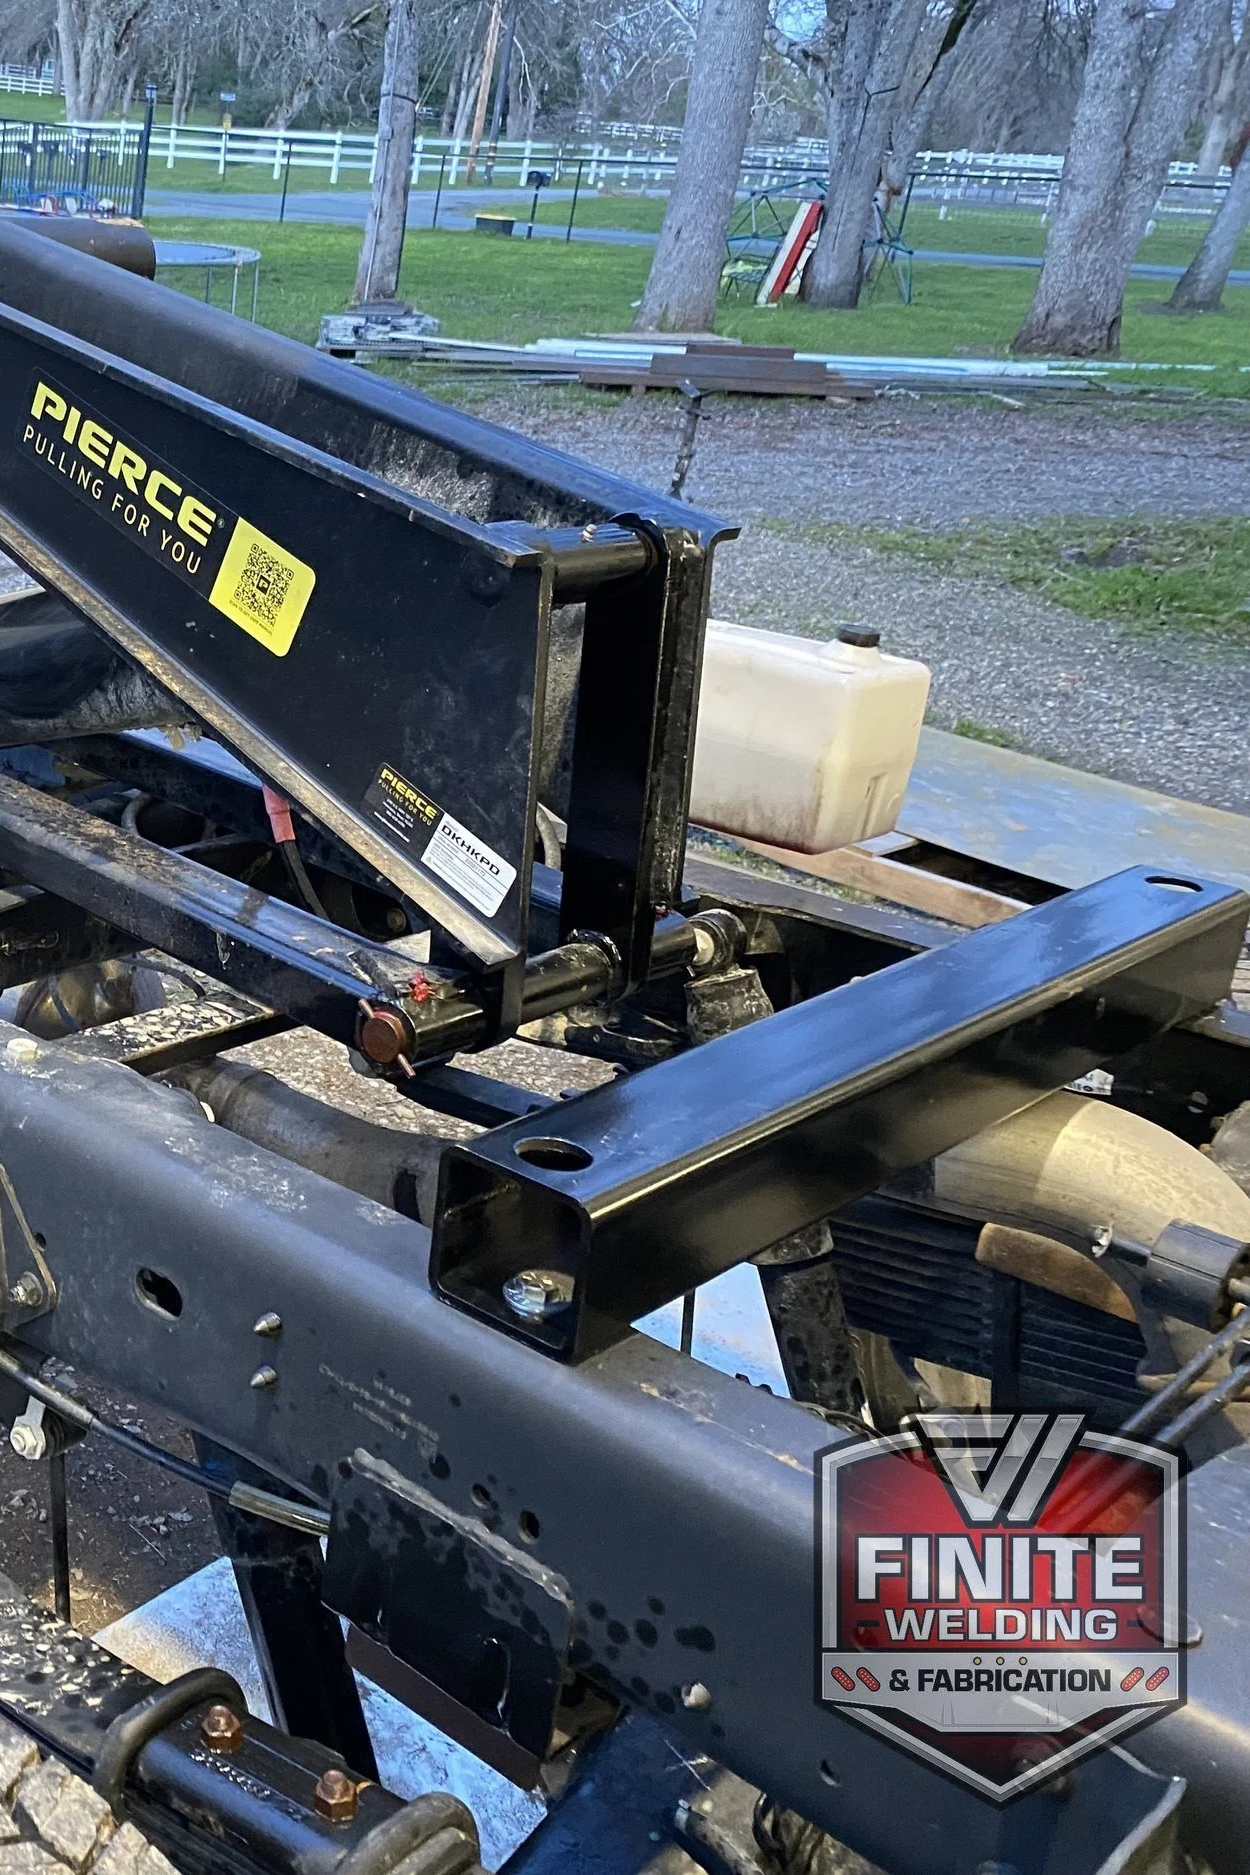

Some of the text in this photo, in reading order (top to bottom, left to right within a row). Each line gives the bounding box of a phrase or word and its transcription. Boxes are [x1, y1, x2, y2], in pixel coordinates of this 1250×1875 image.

[30, 381, 217, 547] PIERCE
[23, 424, 201, 574] PULLING FOR YOU
[378, 778, 404, 803] PULLING
[405, 801, 418, 814] FOR
[419, 812, 432, 826] YOU
[381, 768, 438, 820] PIERCE
[441, 824, 500, 876] DKHKPD
